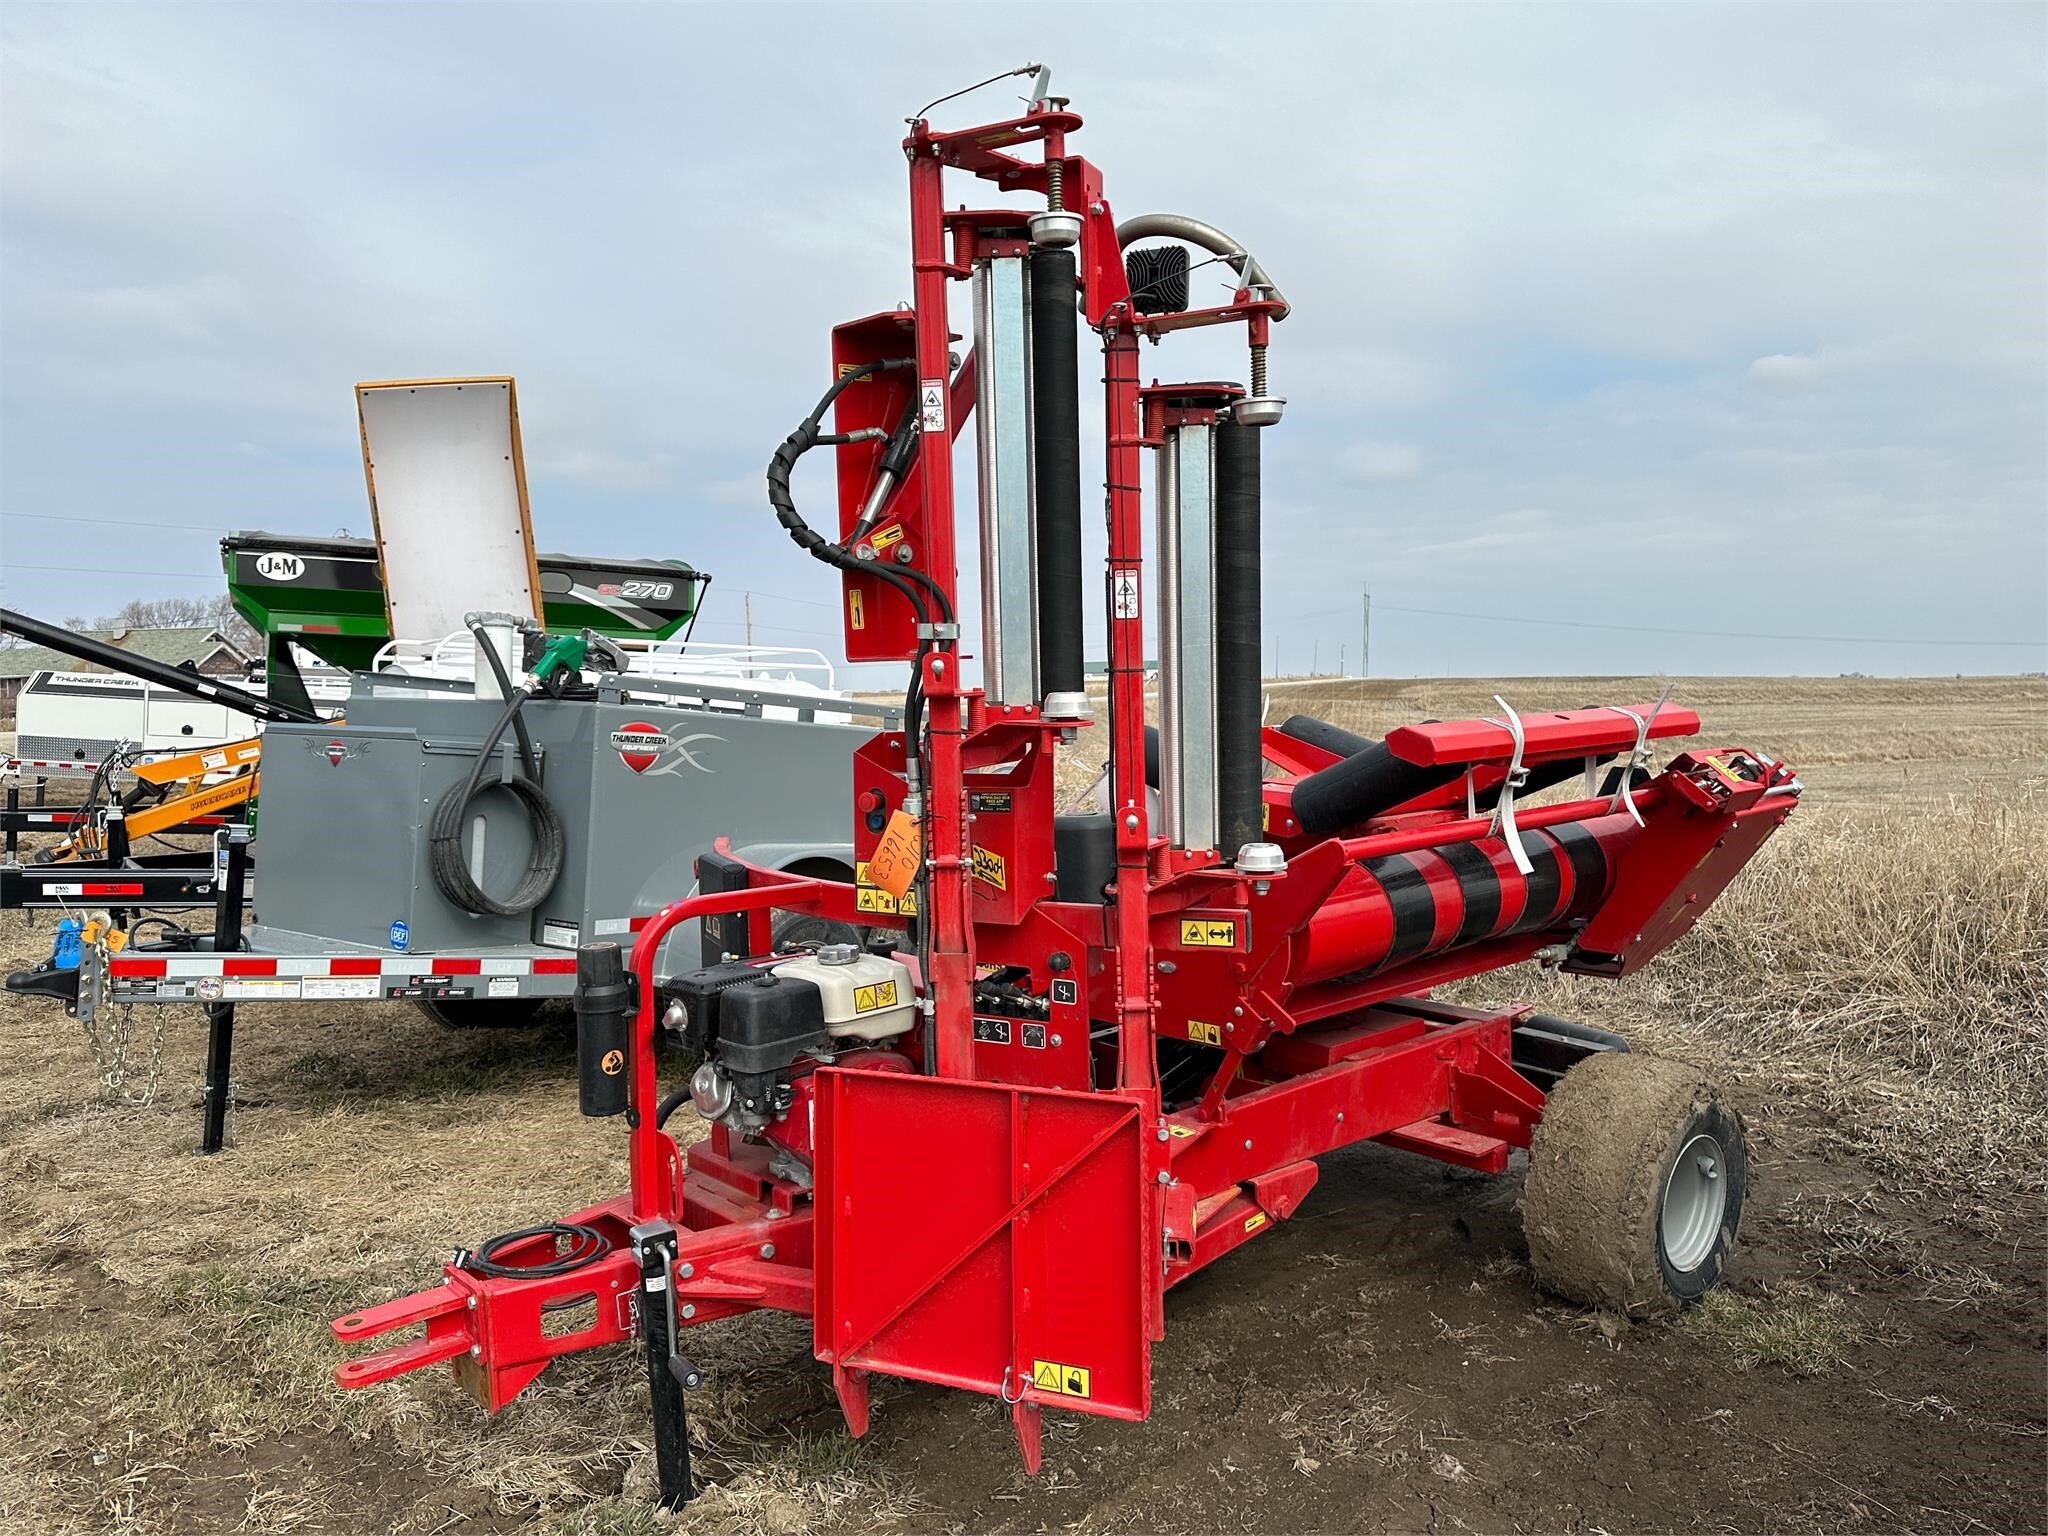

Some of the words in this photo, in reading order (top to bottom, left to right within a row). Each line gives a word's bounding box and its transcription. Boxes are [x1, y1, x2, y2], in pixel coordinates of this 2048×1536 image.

[260, 557, 298, 576] J&M
[55, 675, 101, 684] THUNDER
[103, 678, 139, 687] CREEK
[612, 733, 643, 744] THUNDER
[645, 736, 667, 745] CREEK
[621, 744, 658, 752] EQUIPMENT
[872, 829, 905, 880] 16653
[393, 930, 406, 941] DEF
